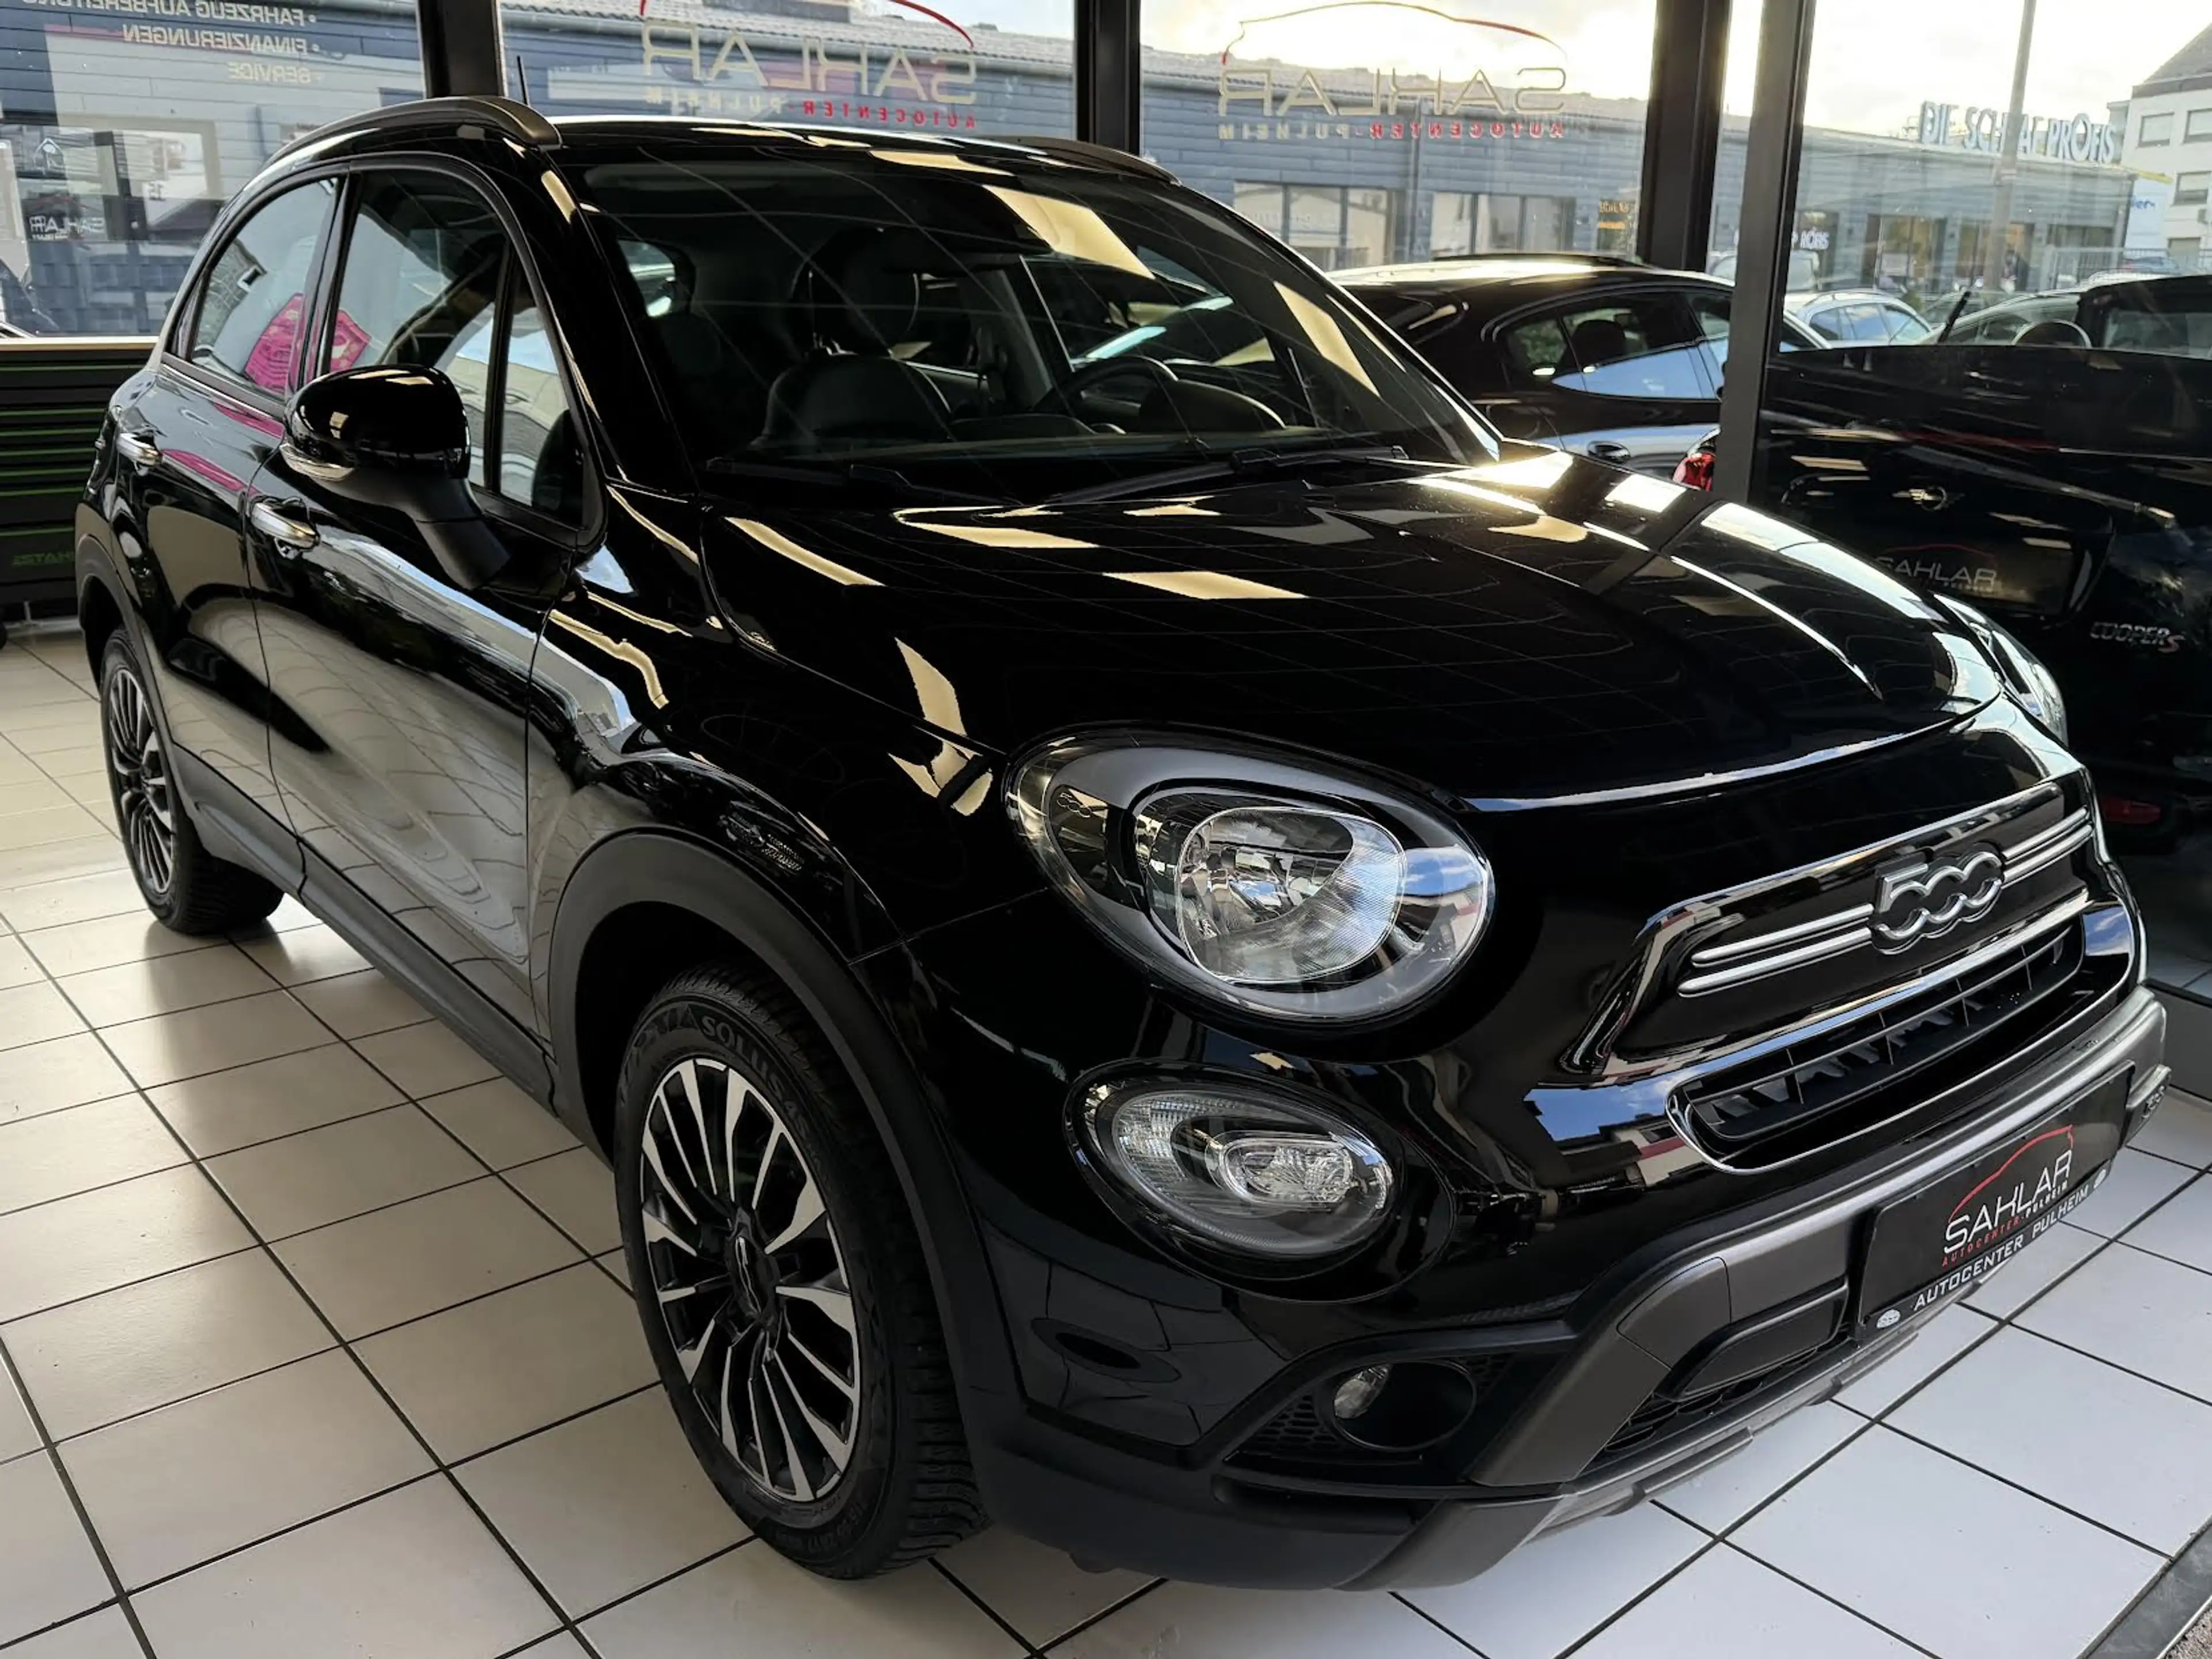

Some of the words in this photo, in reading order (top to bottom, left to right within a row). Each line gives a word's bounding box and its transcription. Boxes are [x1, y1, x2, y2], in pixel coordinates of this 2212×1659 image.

[1875, 851, 2003, 941] 500
[1913, 1234, 2024, 1312] AUTOCENTER
[2032, 1184, 2089, 1238] PULHEIM
[1944, 1149, 2072, 1254] SAHLAR
